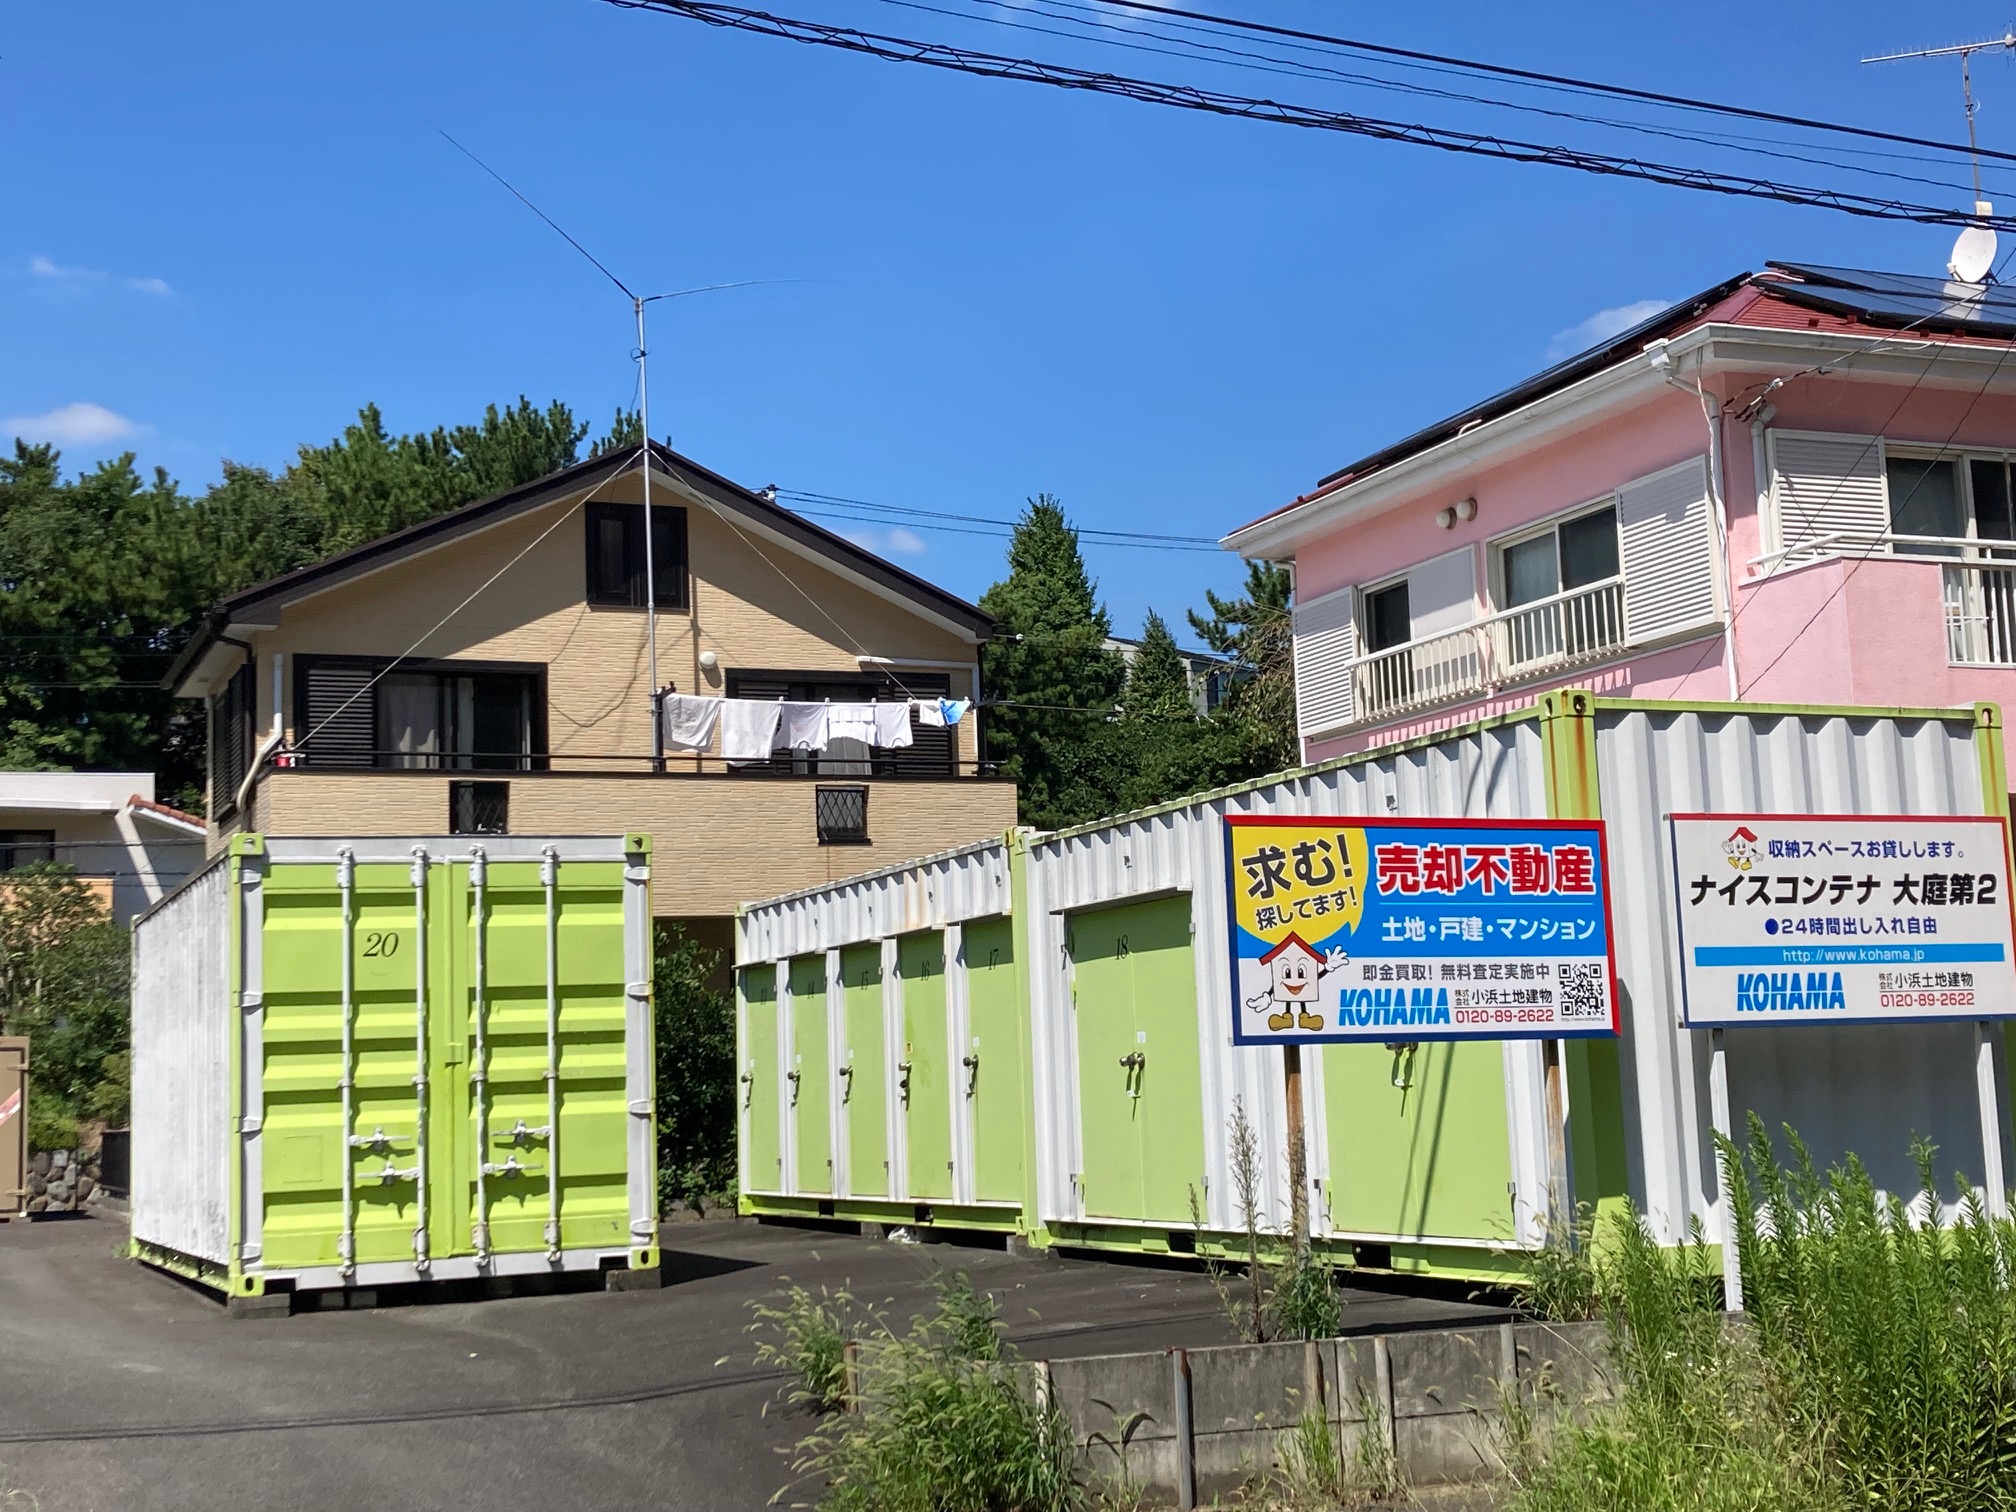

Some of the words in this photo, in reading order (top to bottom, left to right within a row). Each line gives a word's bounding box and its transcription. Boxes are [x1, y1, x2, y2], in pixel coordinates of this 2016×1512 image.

[1768, 839, 1965, 859] 収納スペースお貸しします。
[1241, 833, 1355, 901] 求む！
[1376, 842, 1596, 896] 売却不動産
[1690, 873, 1882, 906] ナイスコンテナ
[1892, 873, 1998, 906] 大庭第2
[1255, 885, 1359, 932] 探してます！
[1381, 916, 1596, 942] 土地・戸建・マンション
[362, 932, 399, 958] 20
[1114, 934, 1129, 961] 18
[1782, 948, 1925, 965] http://www.kohama.jp
[920, 960, 930, 982] 16
[988, 948, 999, 970] 17
[1440, 963, 1551, 981] 無料査定実施中
[1894, 972, 1974, 988] 小浜土地建物
[1471, 988, 1553, 1006] 小浜土地建物
[1736, 971, 1847, 1012] KOHAMA
[1880, 992, 1975, 1007] 0120-89-2622
[1338, 987, 1451, 1027] KOHAMA
[1455, 1009, 1555, 1024] 0120-89-2622
